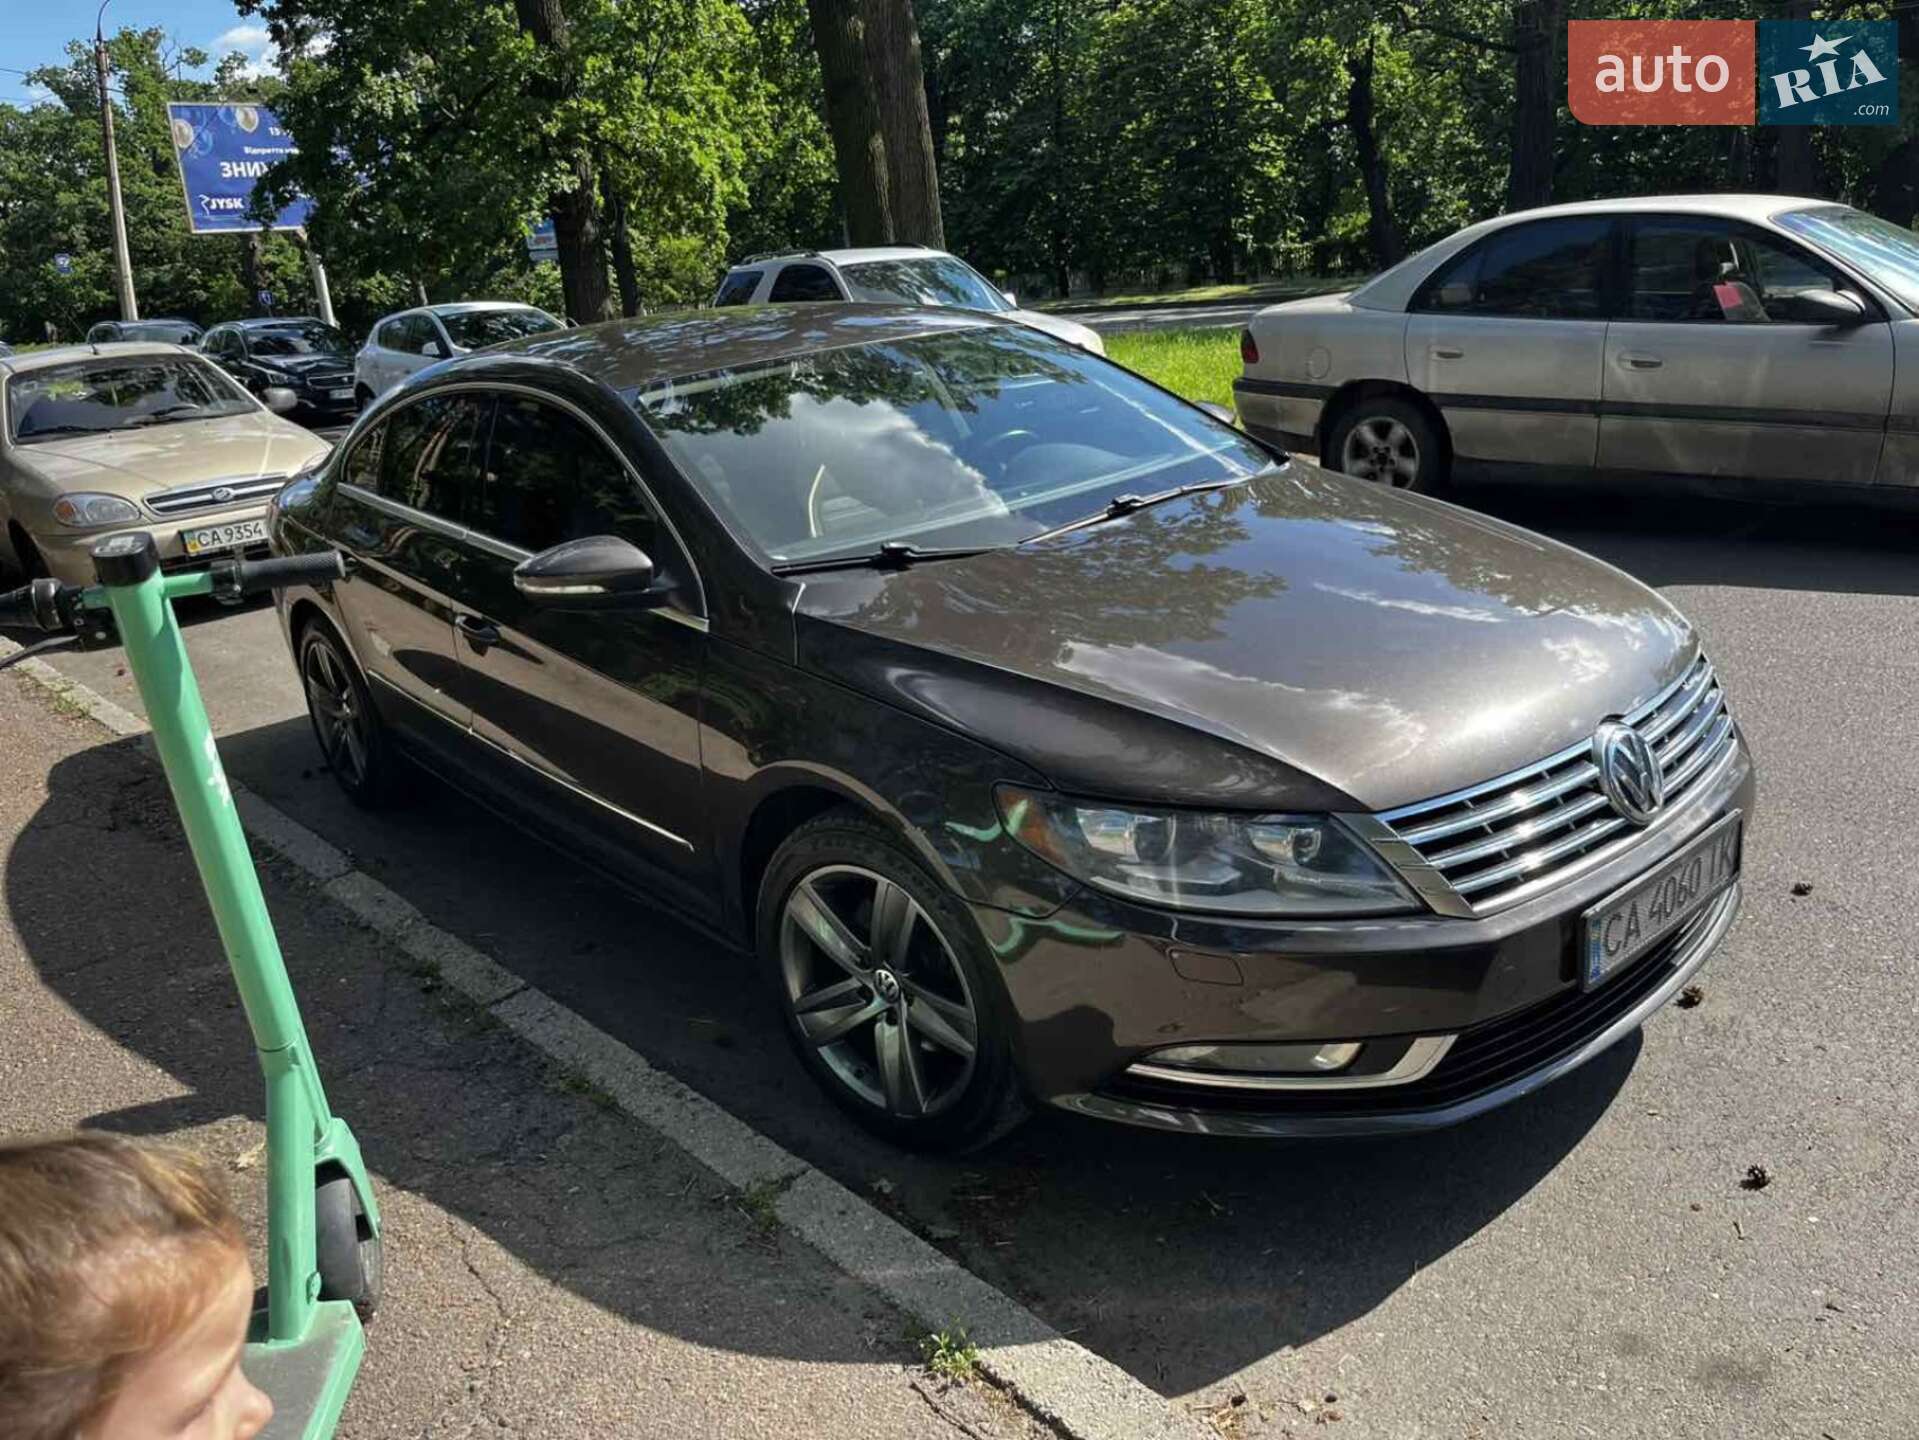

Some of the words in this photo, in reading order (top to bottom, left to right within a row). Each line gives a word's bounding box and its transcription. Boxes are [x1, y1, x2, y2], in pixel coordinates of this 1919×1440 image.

[210, 198, 245, 209] JYSK
[197, 530, 222, 547] CA
[224, 522, 263, 542] 9354
[1603, 900, 1642, 957] CA
[1648, 857, 1703, 925] 4060
